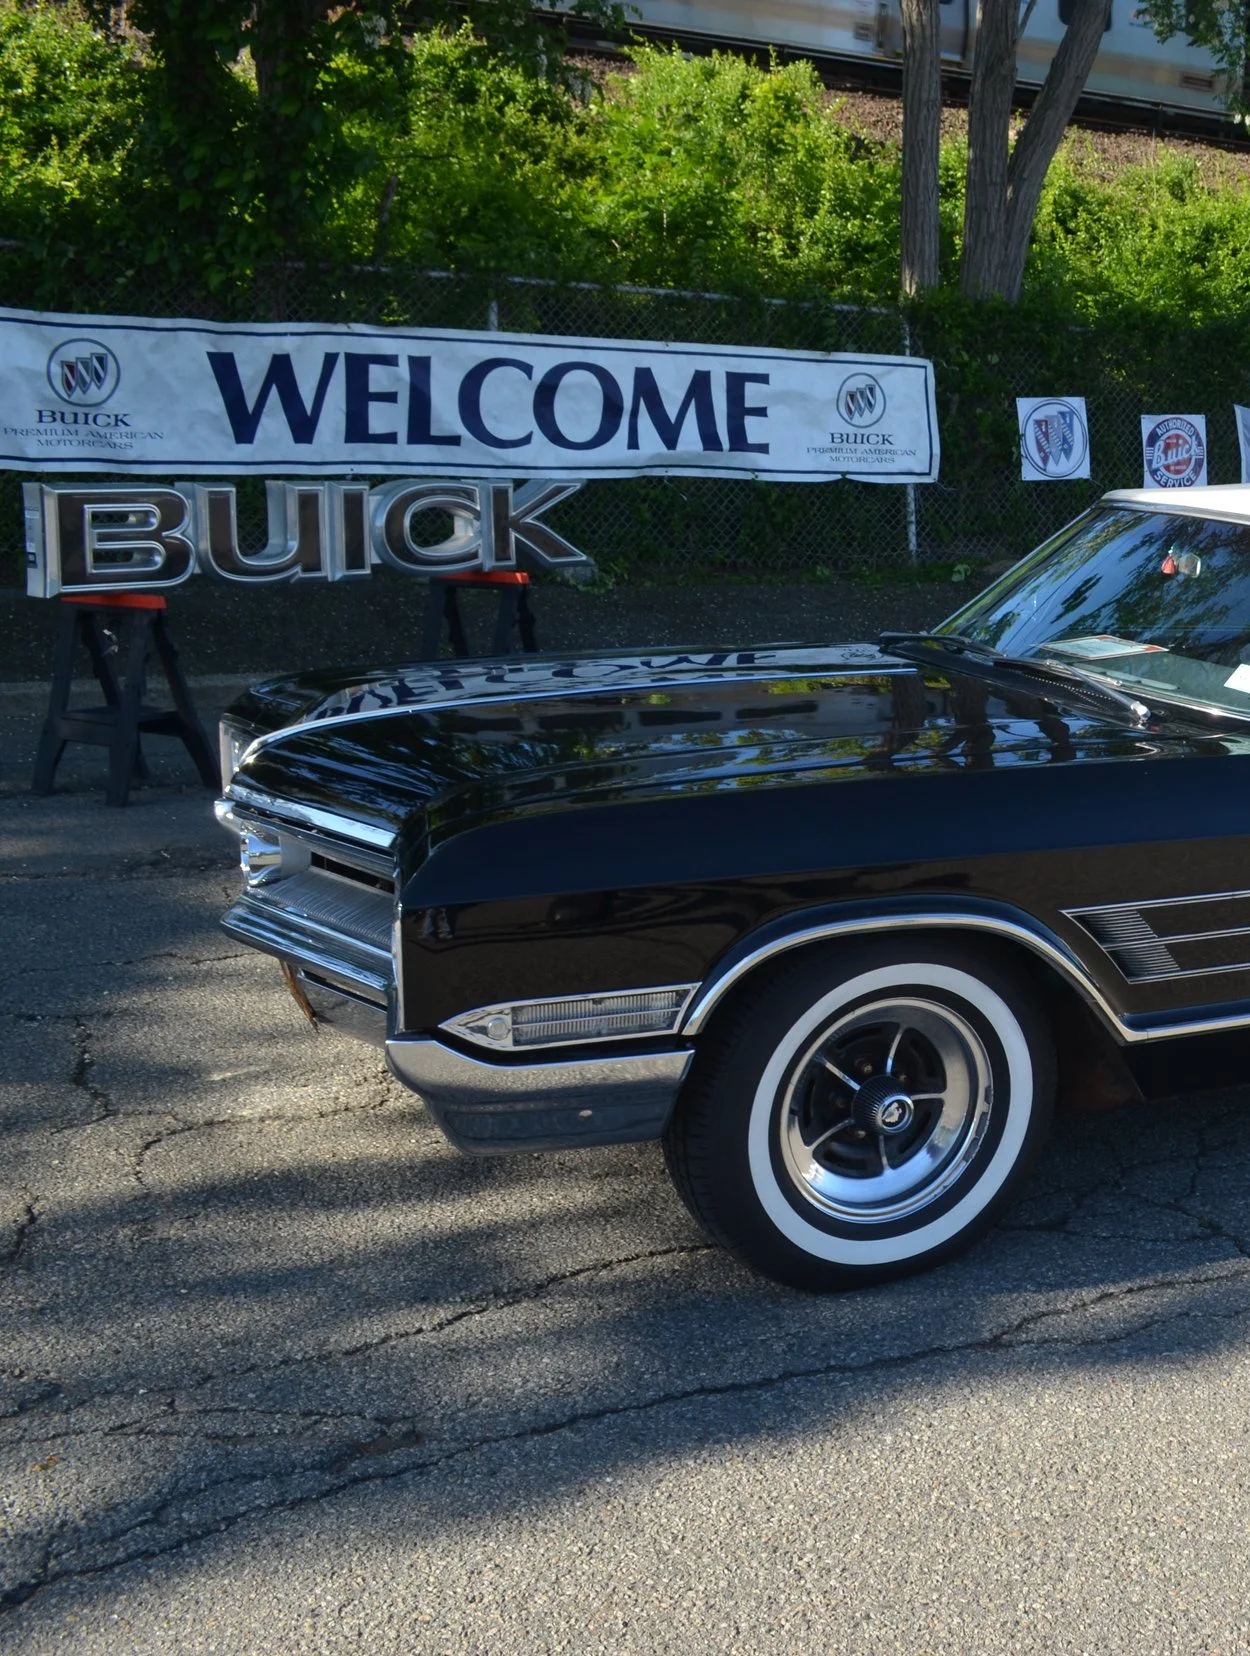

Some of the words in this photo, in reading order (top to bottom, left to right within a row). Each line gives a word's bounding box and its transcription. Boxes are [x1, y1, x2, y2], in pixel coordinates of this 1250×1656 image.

[206, 350, 770, 455] WELCOME
[36, 409, 132, 428] BUICK
[4, 427, 79, 437] PREMIUM
[84, 430, 164, 440] AMERICAN
[1156, 420, 1194, 436] AUTHORIZED
[36, 439, 134, 450] MOTORCARS
[829, 432, 894, 446] BUICK
[806, 447, 857, 455] PREMIUM
[861, 448, 917, 457] AMERICAN
[829, 456, 895, 464] MOTORCARS
[1151, 436, 1198, 468] Buick
[1154, 471, 1196, 487] SERVICE
[22, 480, 594, 599] BUICK
